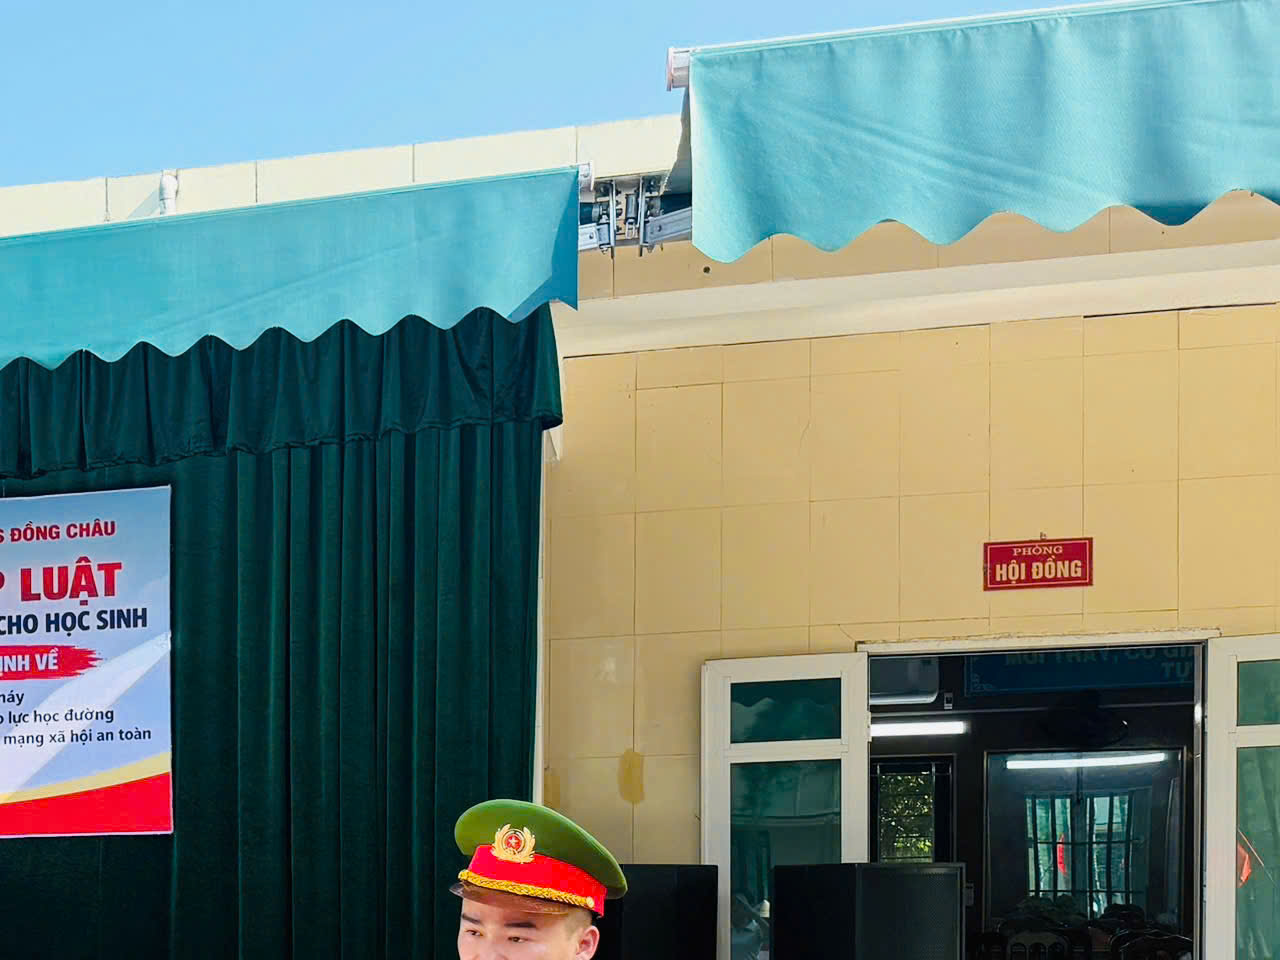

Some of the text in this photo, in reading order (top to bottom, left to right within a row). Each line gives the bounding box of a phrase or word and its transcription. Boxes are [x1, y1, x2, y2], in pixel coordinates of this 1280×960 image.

[10, 520, 61, 543] ĐỒNG
[66, 518, 116, 539] CHÂU
[1013, 544, 1063, 556] PHÒNG
[20, 556, 122, 606] LUẬT
[995, 555, 1082, 584] HỘI ĐỒNG
[45, 610, 90, 637] HỌC
[96, 607, 148, 630] SINH
[35, 647, 59, 670] VỀ
[8, 711, 29, 727] lực
[33, 710, 60, 726] học
[64, 708, 114, 723] đường
[4, 734, 44, 748] mạng
[49, 730, 66, 743] xã
[70, 729, 93, 745] hội
[97, 731, 114, 742] an
[119, 727, 152, 741] toàn
